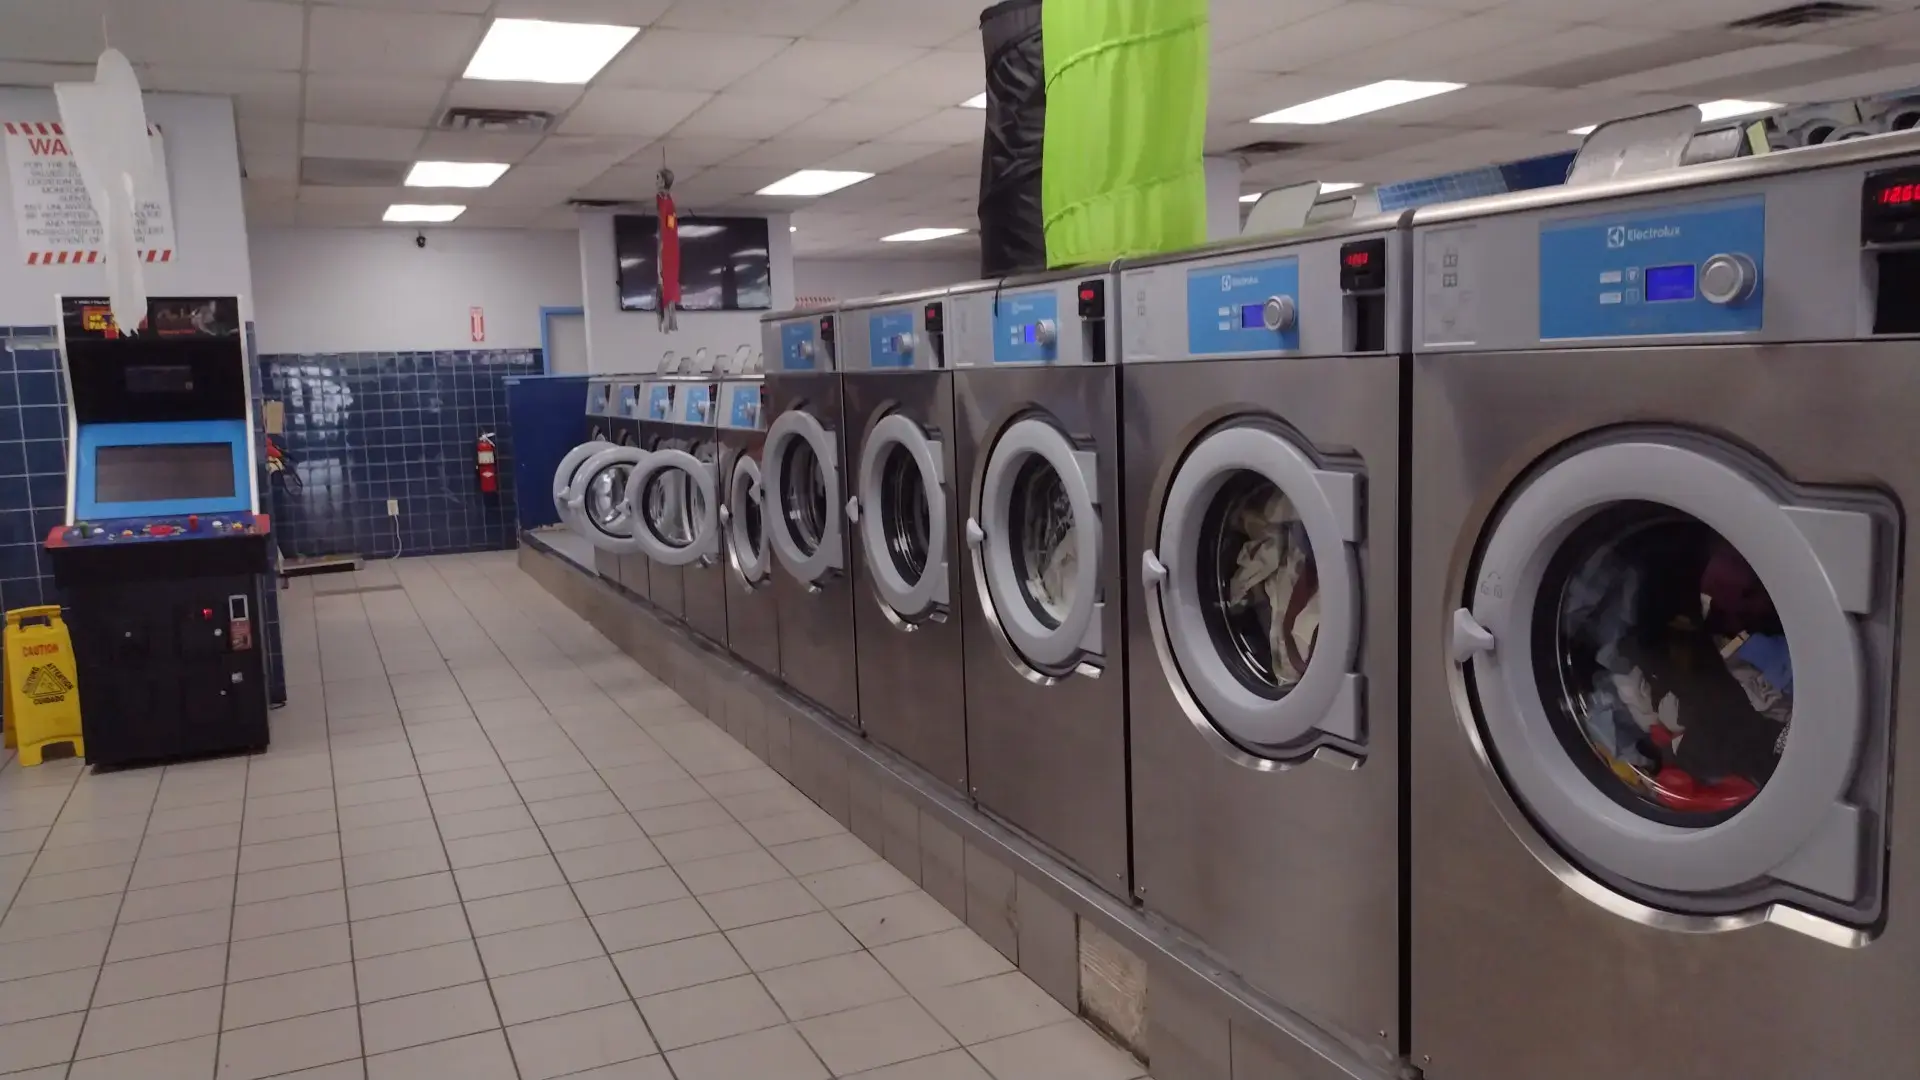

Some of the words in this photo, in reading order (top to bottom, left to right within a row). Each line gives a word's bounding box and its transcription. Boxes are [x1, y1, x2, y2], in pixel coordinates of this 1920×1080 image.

[28, 138, 73, 156] WA
[1627, 225, 1681, 242] Electrolux
[22, 643, 60, 657] CAUTION
